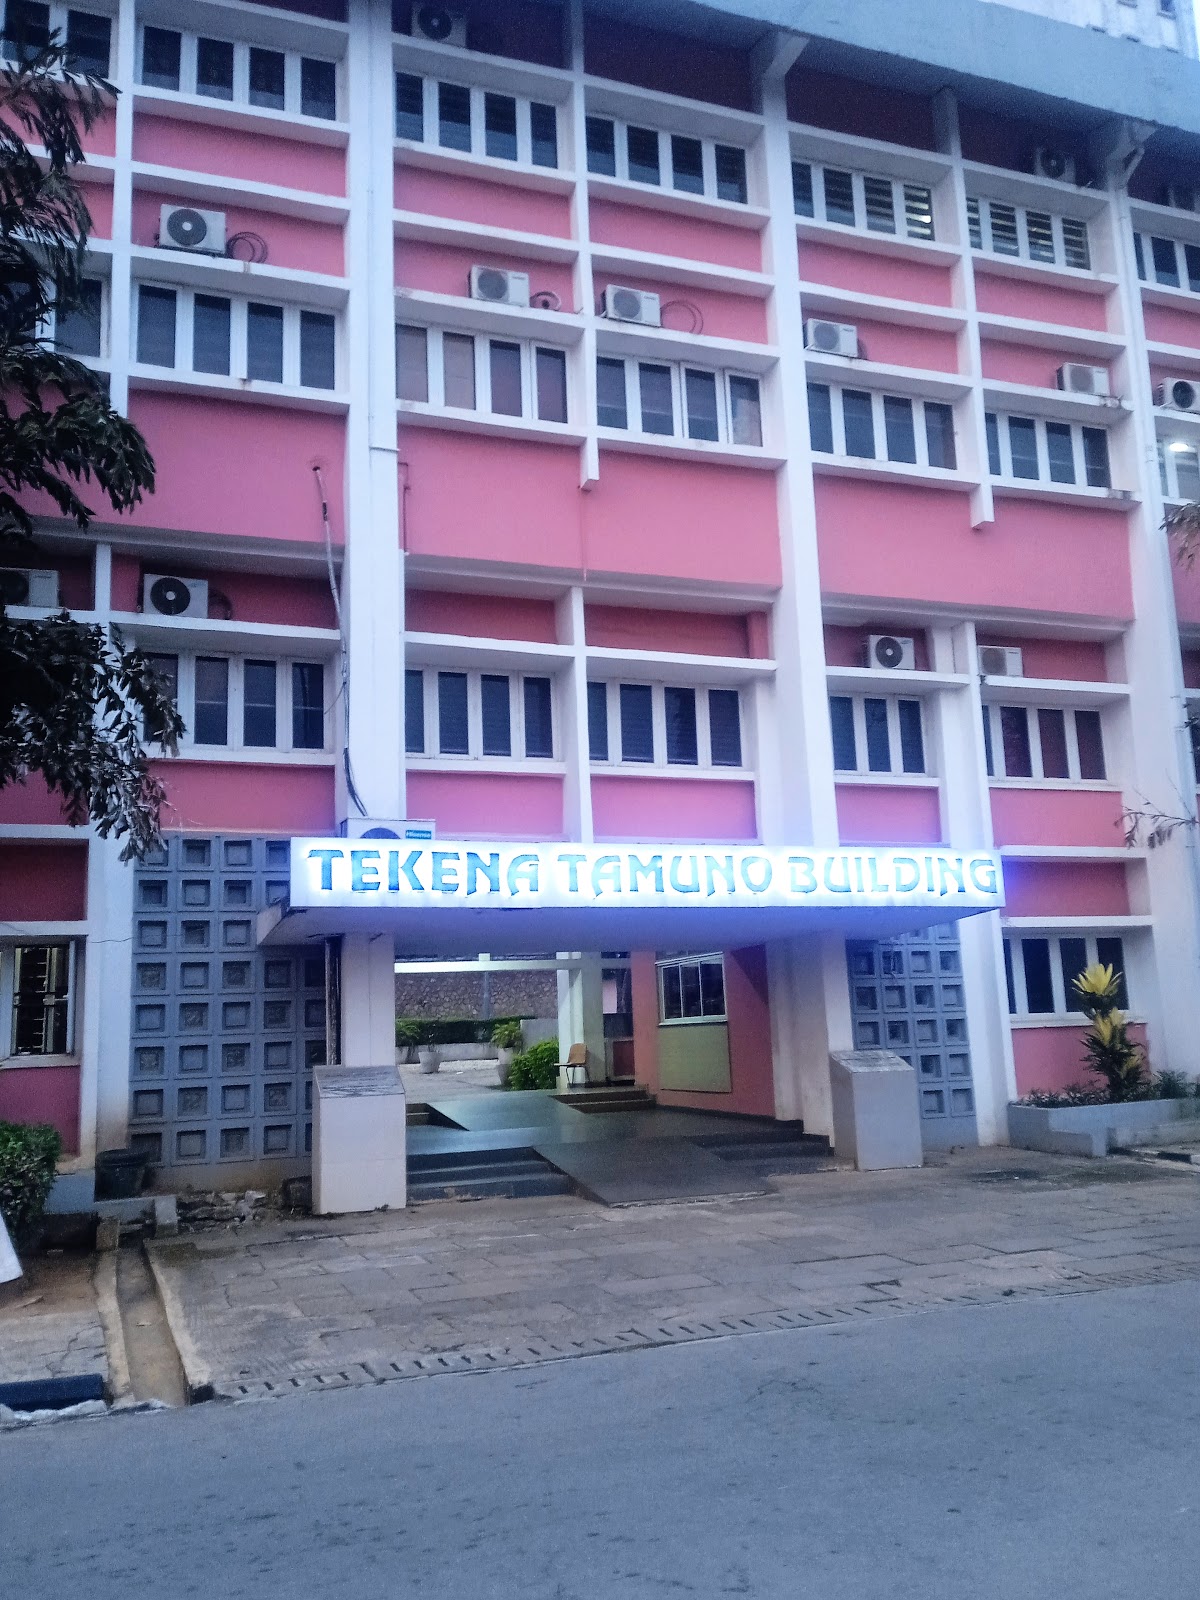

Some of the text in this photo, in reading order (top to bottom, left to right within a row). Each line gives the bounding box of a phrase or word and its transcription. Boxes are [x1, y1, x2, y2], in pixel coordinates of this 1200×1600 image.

[307, 849, 998, 898] TEKENA TAMUNO BUILDING
